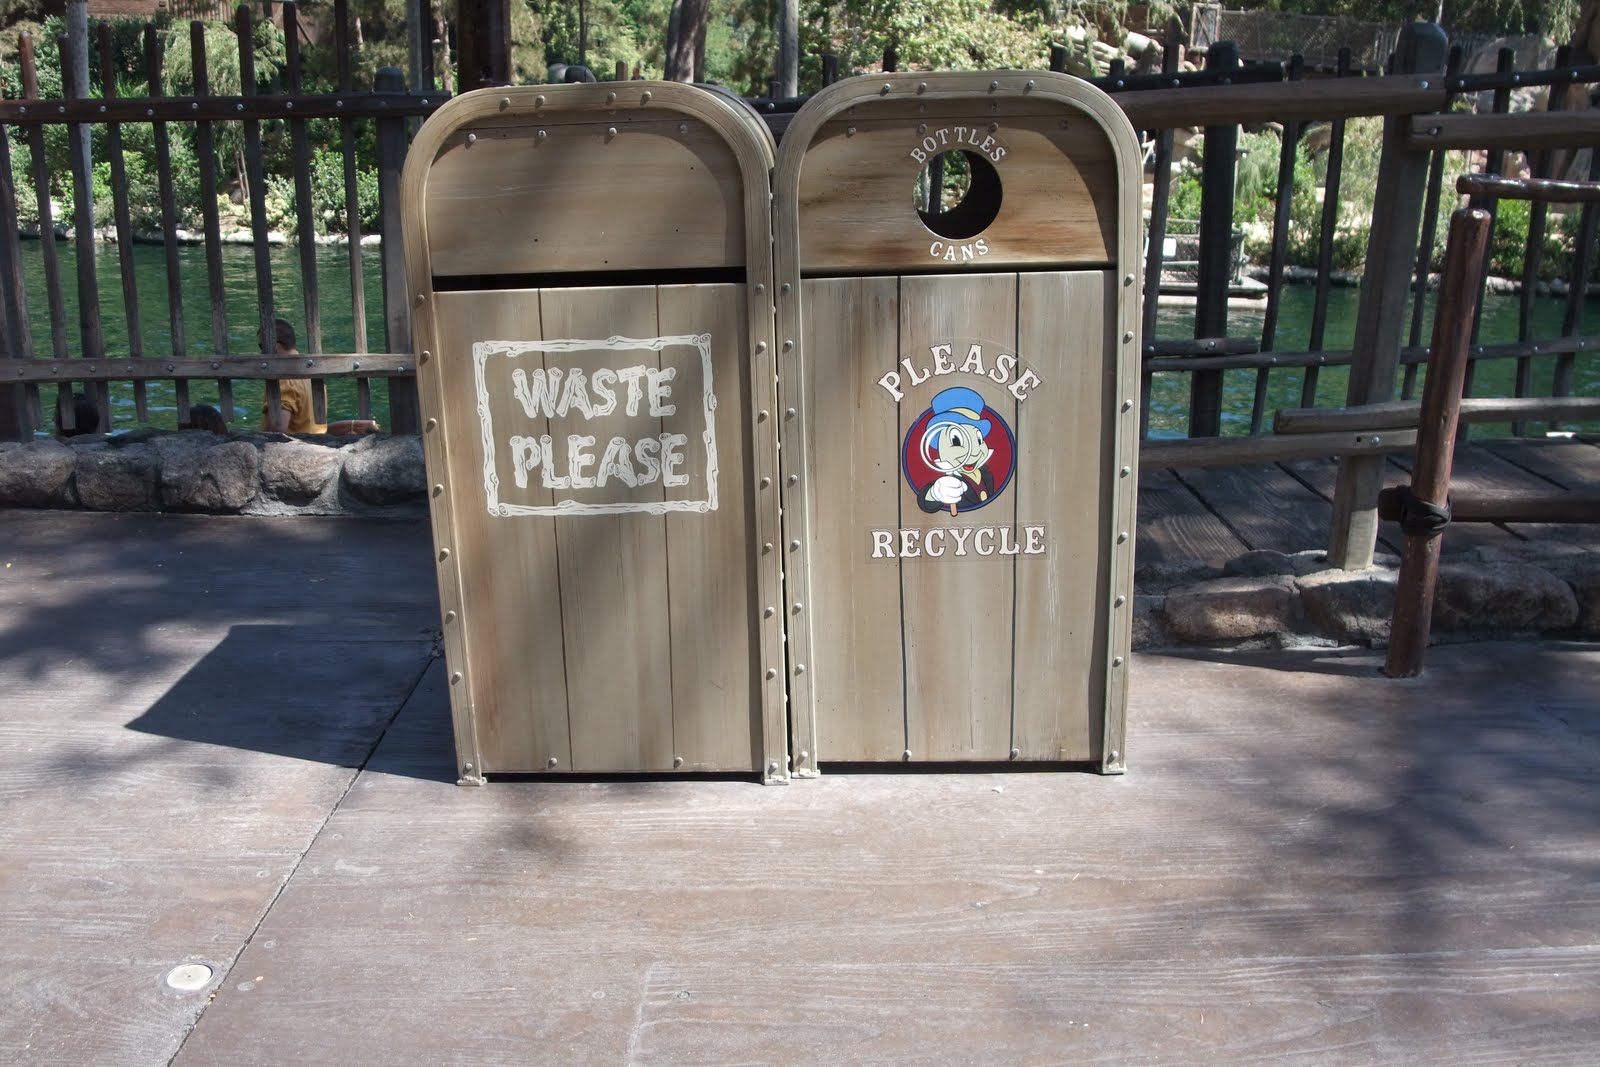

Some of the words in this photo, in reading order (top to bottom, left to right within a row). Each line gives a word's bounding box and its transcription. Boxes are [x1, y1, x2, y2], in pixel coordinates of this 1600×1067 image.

[910, 126, 1006, 163] BOTTLES
[929, 239, 989, 261] CANS
[511, 365, 676, 420] WASTE
[877, 343, 1042, 402] PLEASE
[510, 433, 689, 489] PLEASE
[871, 526, 1046, 558] RECYCLE
